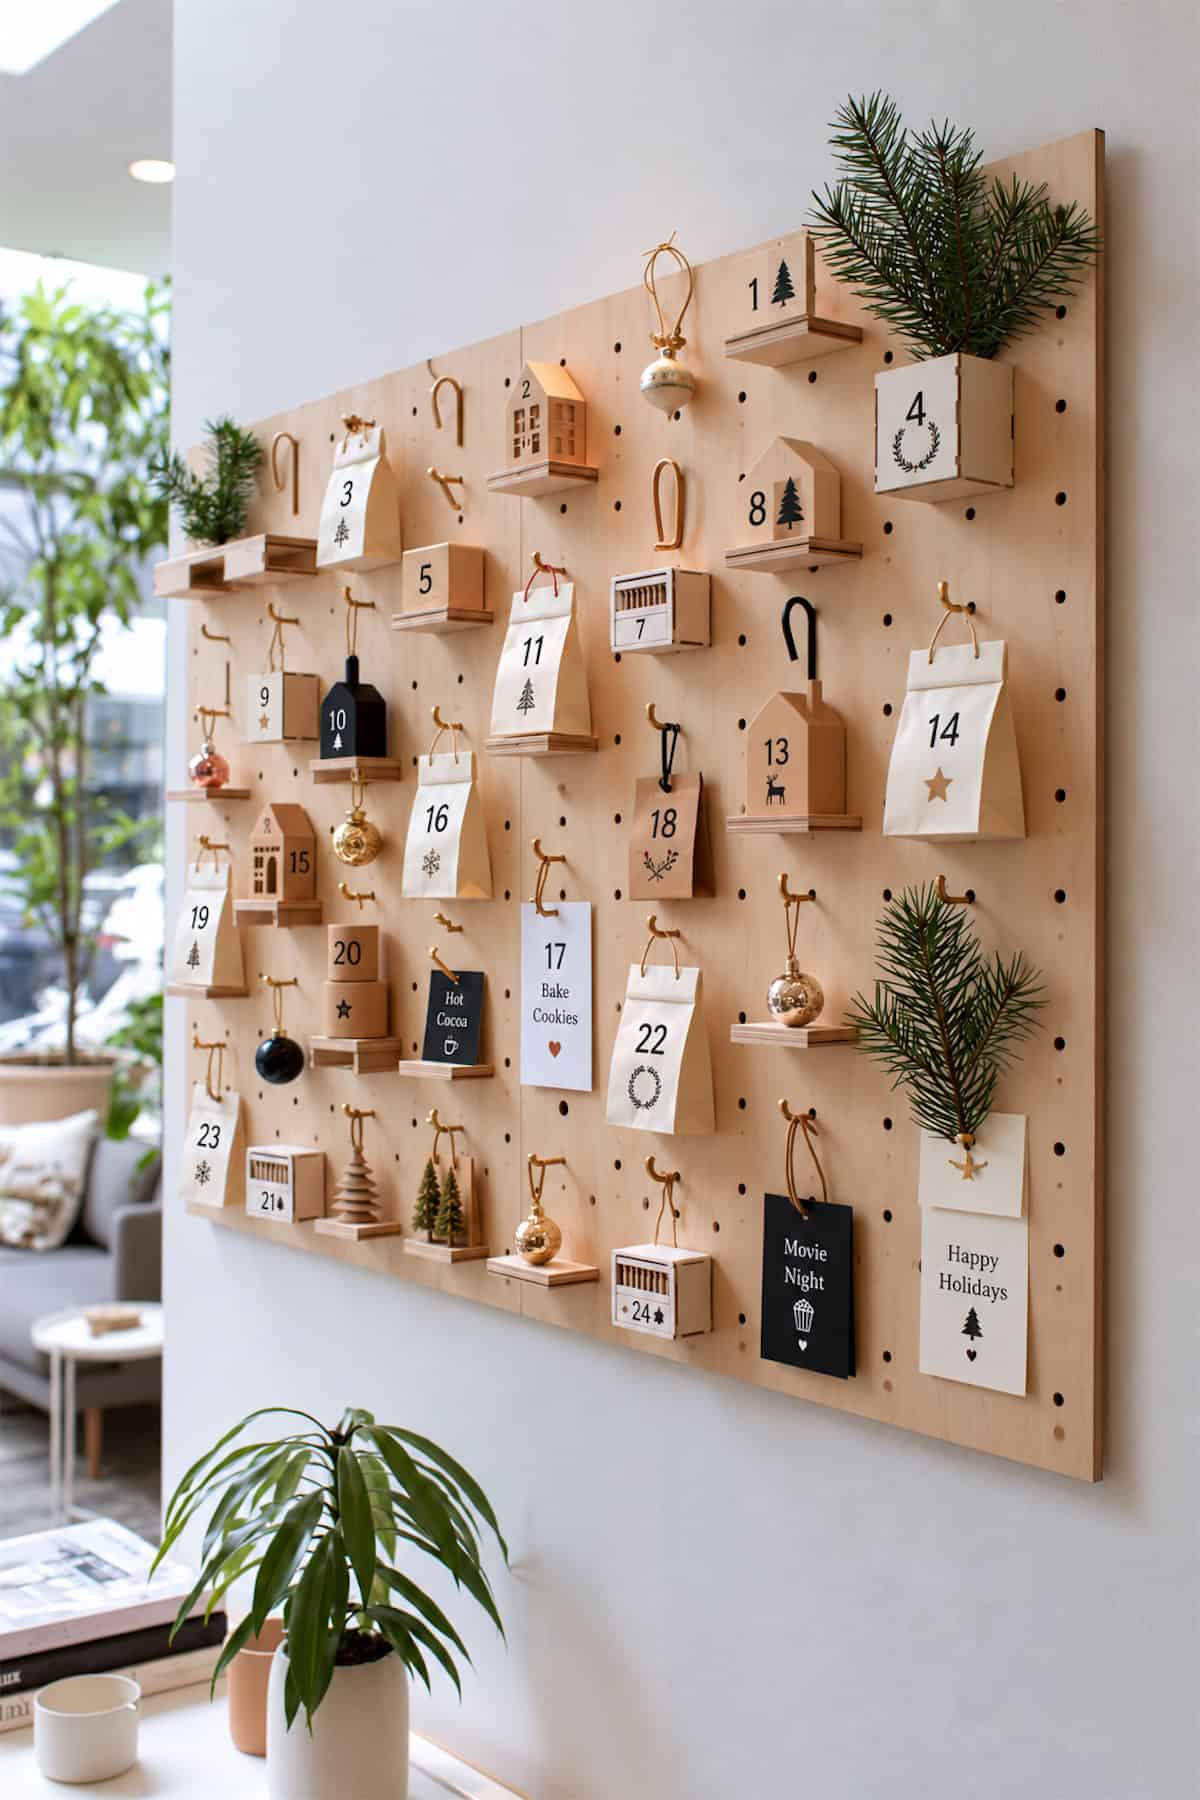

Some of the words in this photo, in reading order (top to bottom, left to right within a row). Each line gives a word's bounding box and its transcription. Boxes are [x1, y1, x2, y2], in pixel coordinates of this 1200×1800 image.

[748, 277, 758, 312] 1
[521, 379, 531, 400] 2
[905, 391, 926, 427] 4
[339, 480, 354, 508] 3
[748, 491, 767, 528] 8
[419, 563, 433, 595] 5
[635, 618, 646, 640] 7
[523, 635, 544, 667] 11
[260, 686, 270, 708] 9
[329, 709, 346, 731] 10
[928, 711, 960, 749] 14
[764, 737, 789, 766] 13
[426, 803, 449, 833] 16
[651, 807, 678, 839] 18
[290, 851, 311, 874] 15
[191, 905, 209, 930] 19
[333, 940, 362, 966] 20
[544, 942, 567, 970] 17
[445, 991, 464, 1006] Hot
[541, 982, 570, 999] Bake
[436, 1011, 468, 1028] Cocoa
[532, 1007, 579, 1026] Cookies
[634, 1023, 668, 1056] 22
[196, 1122, 221, 1150] 23
[261, 1191, 275, 1210] 21
[784, 1238, 828, 1262] Movie
[947, 1245, 1000, 1273] Happy
[784, 1266, 825, 1293] Night
[939, 1271, 1008, 1302] Holidays
[632, 1301, 652, 1323] 24
